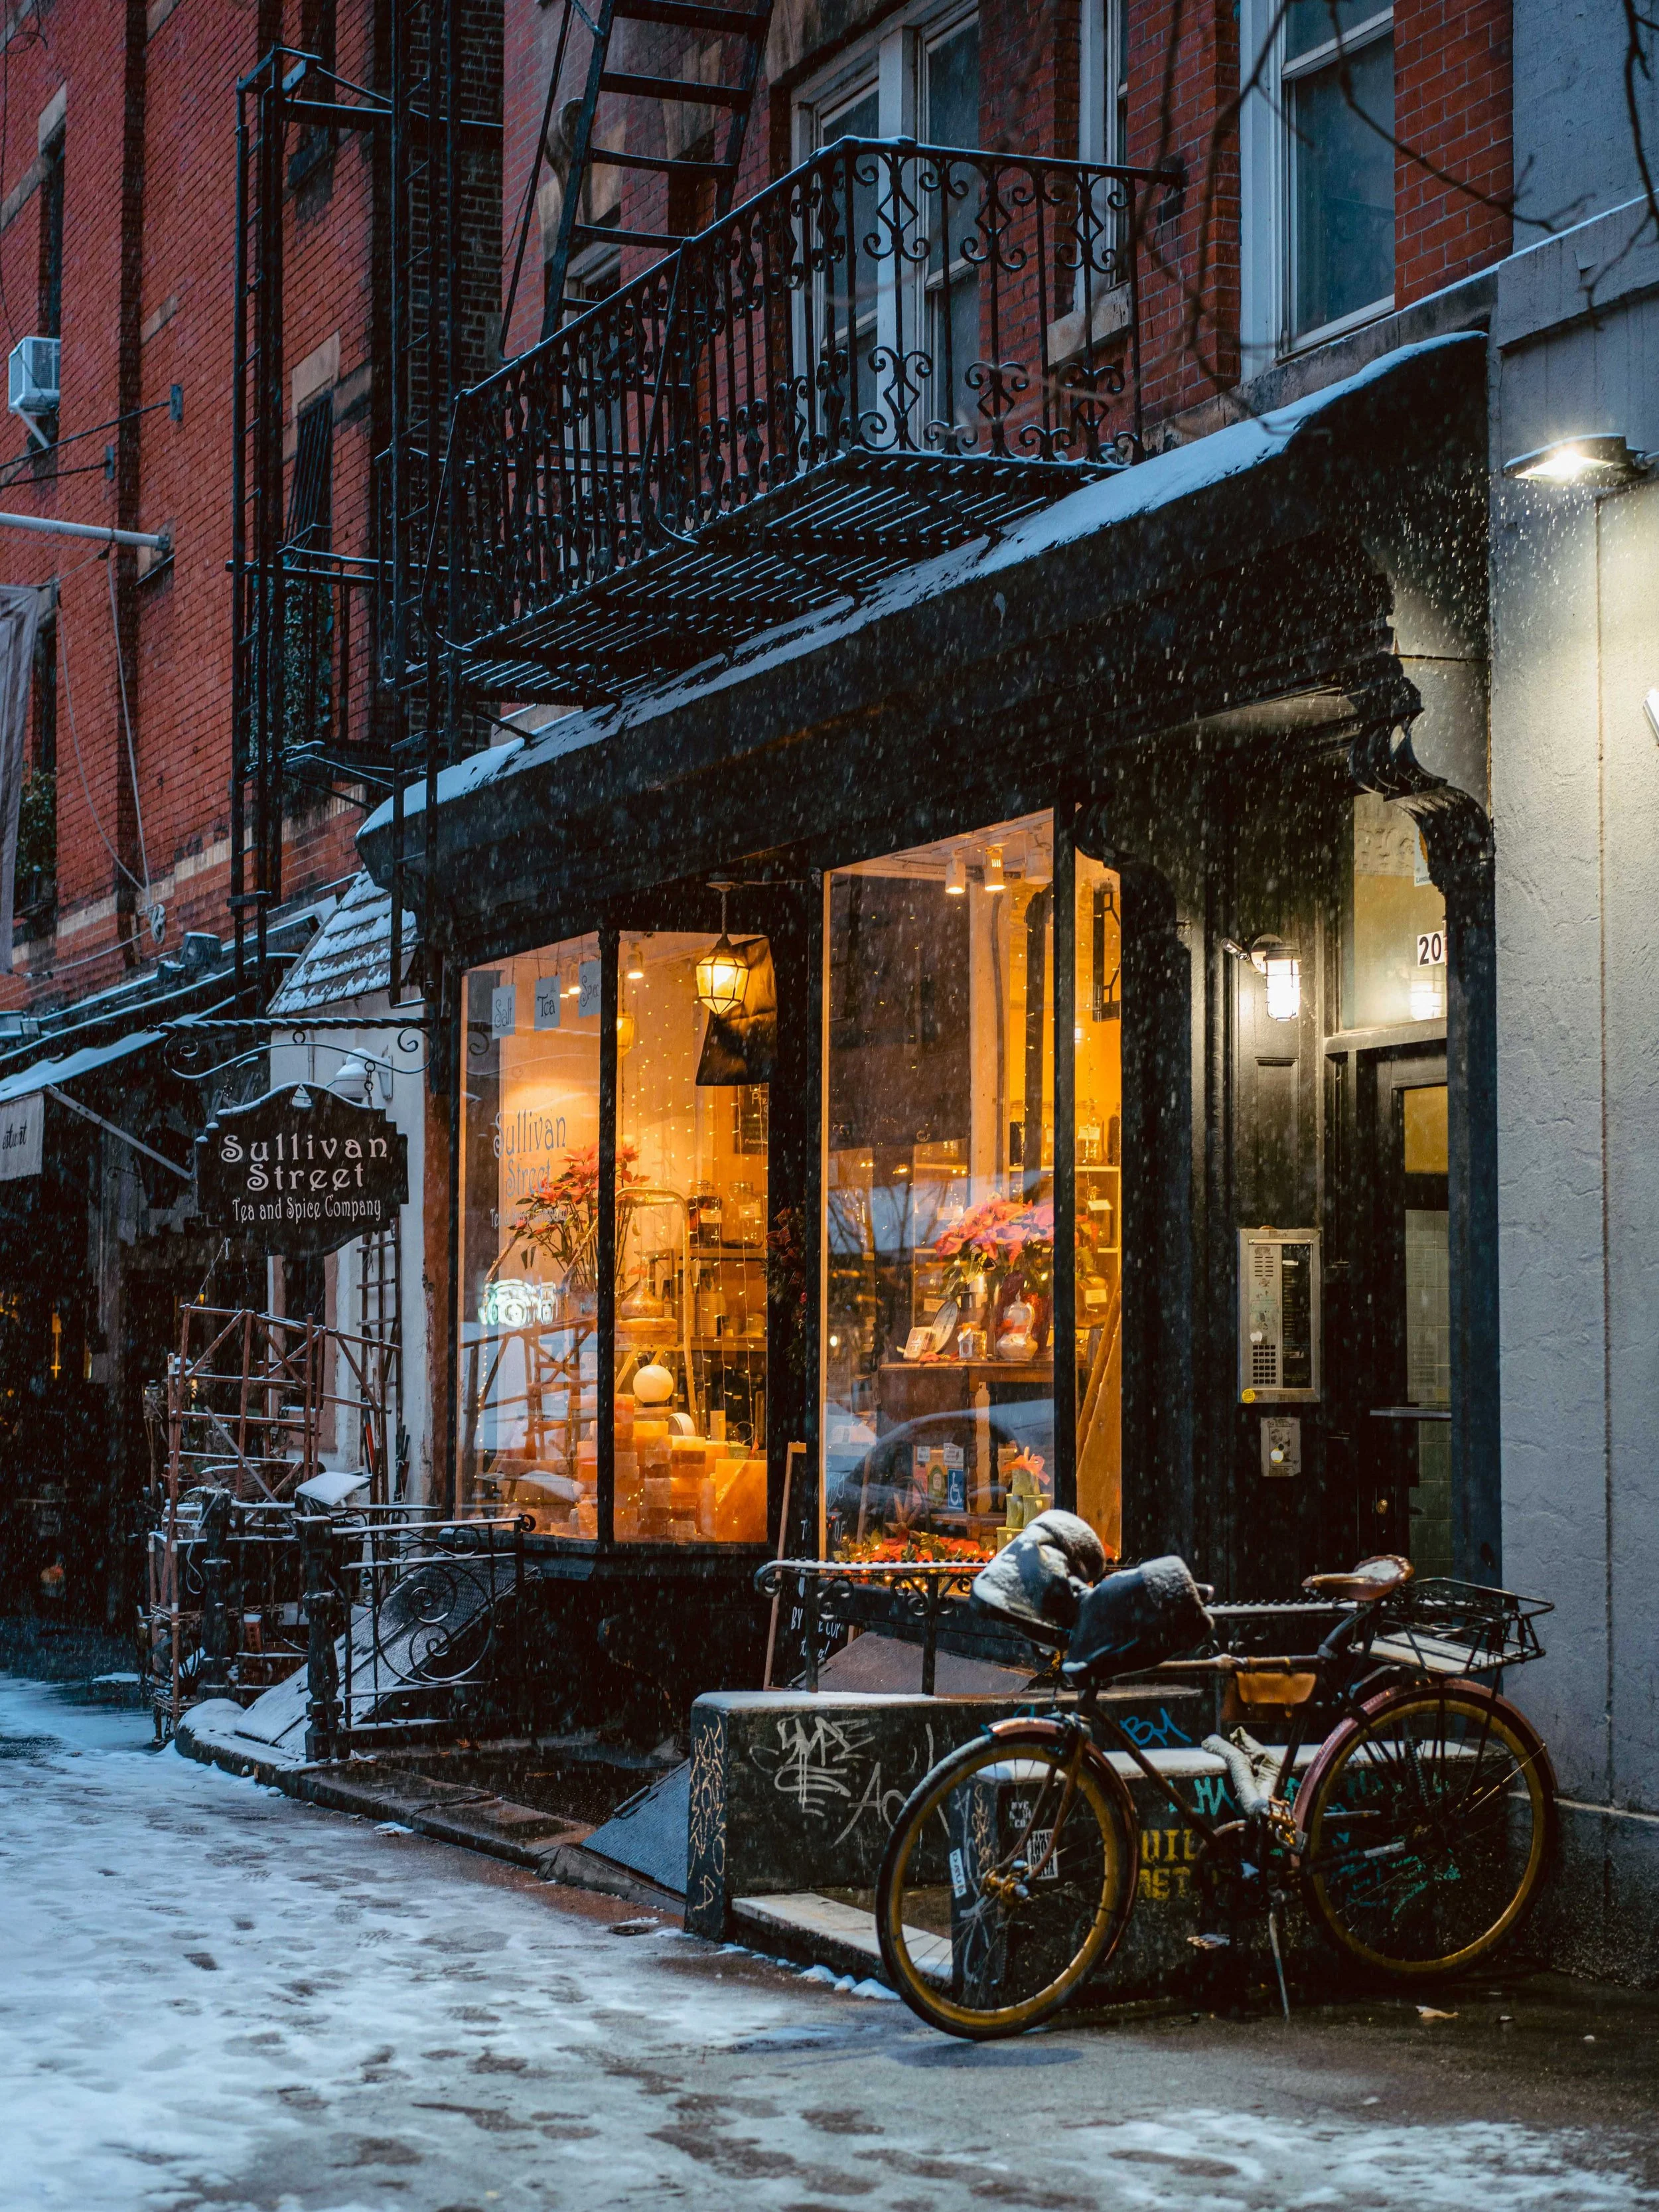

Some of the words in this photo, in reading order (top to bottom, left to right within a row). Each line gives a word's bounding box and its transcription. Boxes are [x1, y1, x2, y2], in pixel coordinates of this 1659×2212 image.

[1418, 933, 1441, 965] 20
[494, 997, 512, 1028] Salt
[537, 994, 555, 1019] Tea
[220, 1132, 387, 1163] Sullivan
[493, 1109, 566, 1158] Sullivan
[246, 1163, 364, 1191] Street
[506, 1157, 551, 1197] Street
[232, 1197, 255, 1223] Tea
[259, 1197, 282, 1220] and
[286, 1197, 321, 1224] Spice
[325, 1195, 381, 1222] Company
[790, 1606, 803, 1630] BY
